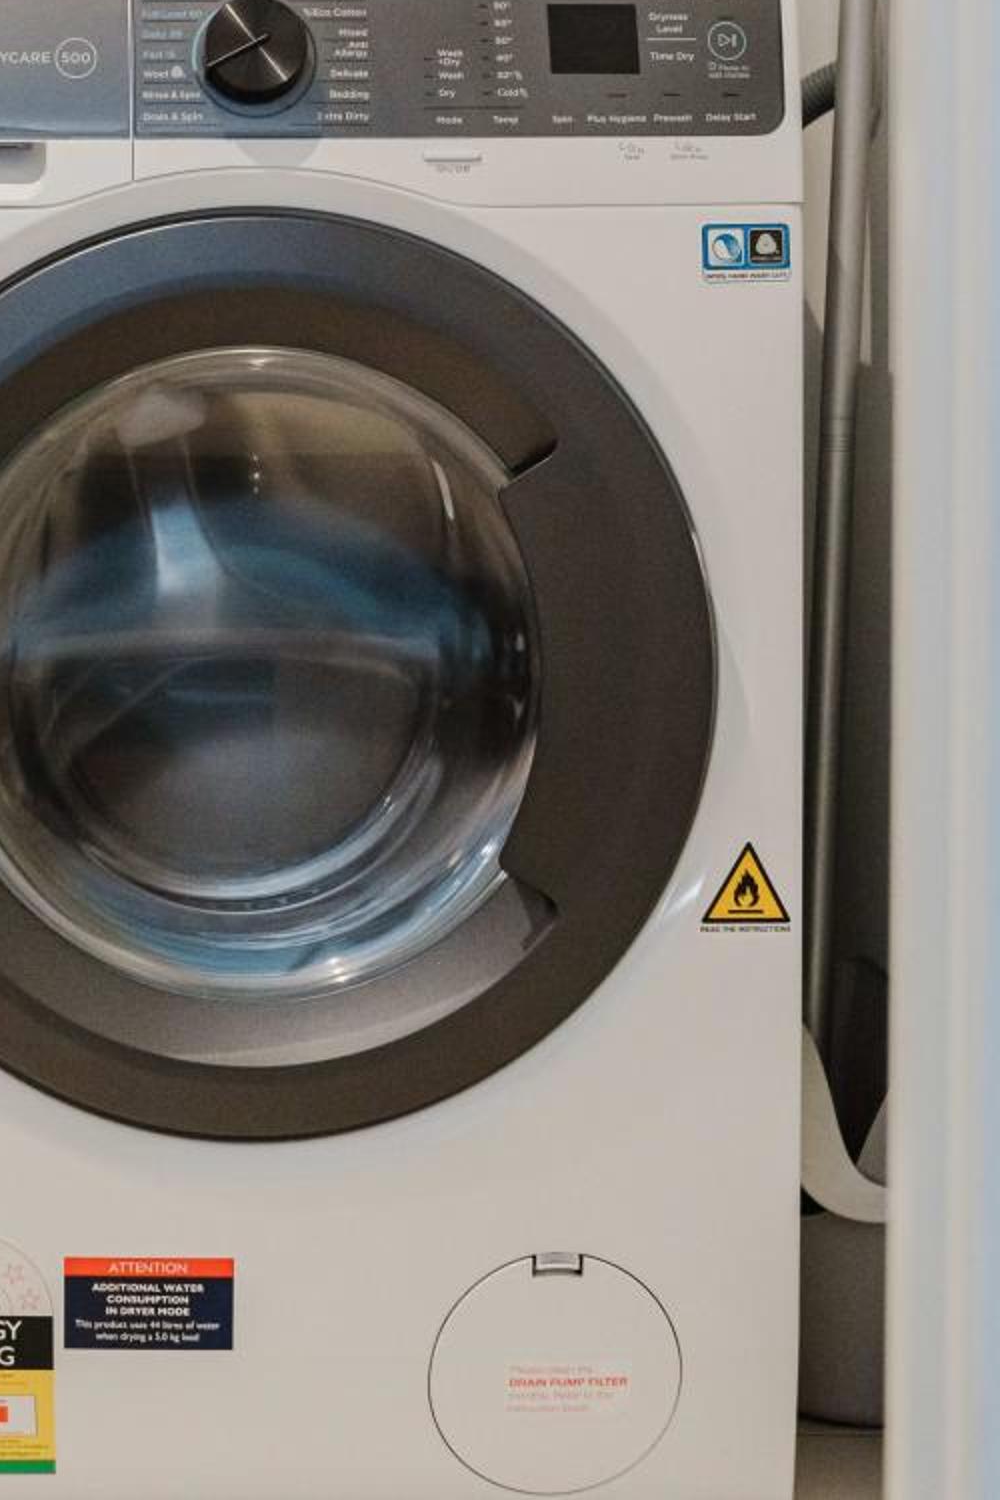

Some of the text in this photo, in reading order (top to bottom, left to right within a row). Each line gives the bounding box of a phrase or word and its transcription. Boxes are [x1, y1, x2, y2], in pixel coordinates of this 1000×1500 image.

[656, 24, 683, 34] Level
[61, 52, 91, 64] 500
[650, 51, 695, 62] Time Dry
[108, 1261, 188, 1274] ATTENTION
[92, 1283, 204, 1293] ADDITIONAL WATER
[106, 1296, 189, 1305] CONSUMPTION
[106, 1307, 190, 1316] IN DRYER MODE
[75, 1319, 92, 1329] This
[94, 1319, 127, 1331] product
[185, 1320, 194, 1329] of
[120, 1333, 146, 1343] drying
